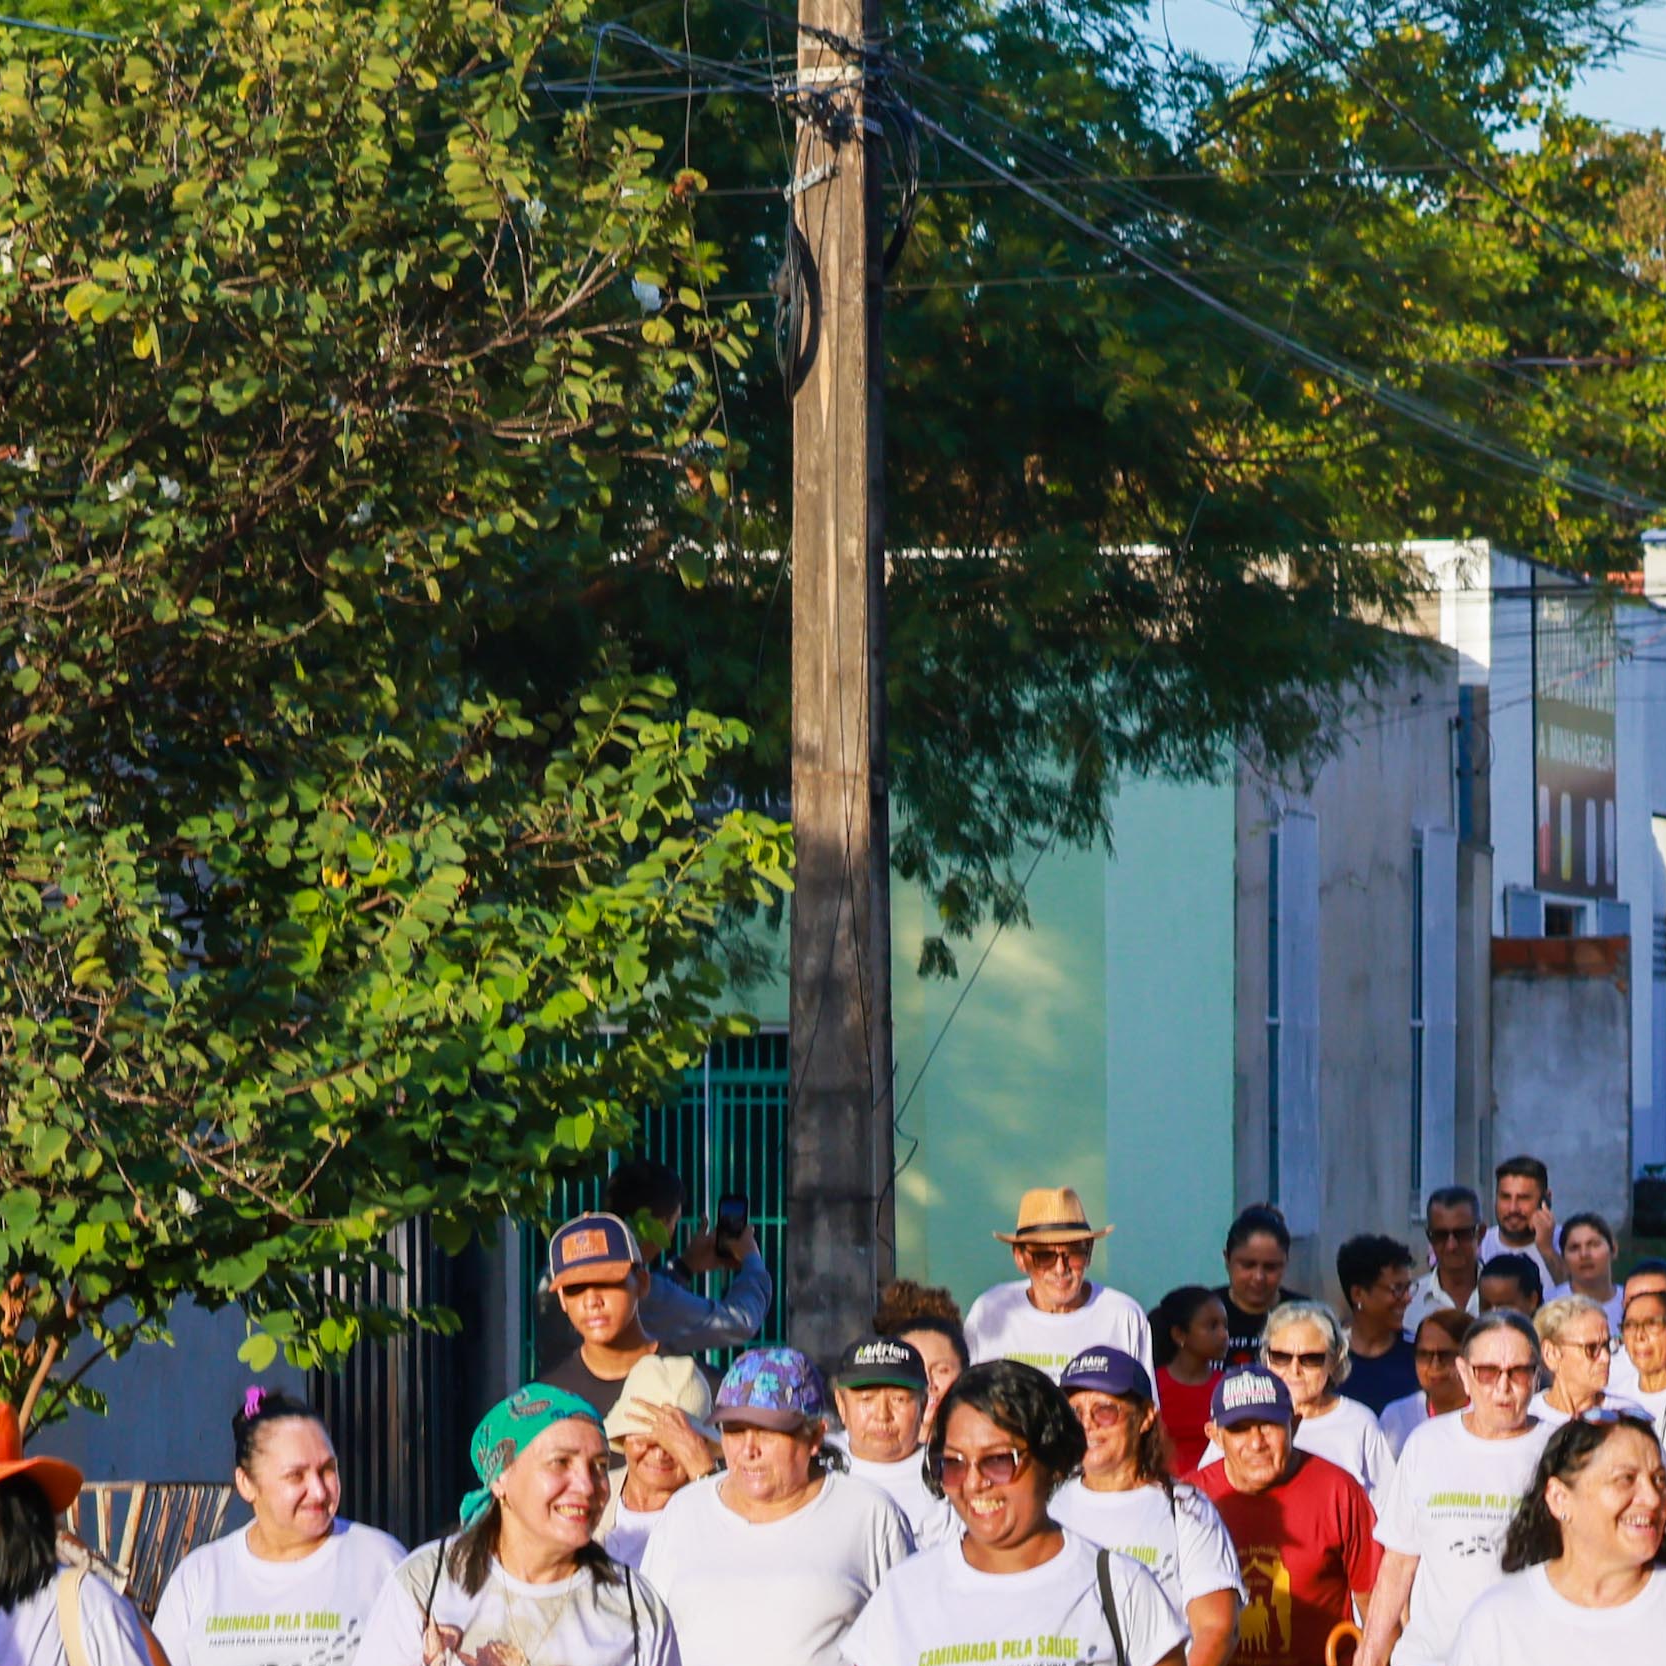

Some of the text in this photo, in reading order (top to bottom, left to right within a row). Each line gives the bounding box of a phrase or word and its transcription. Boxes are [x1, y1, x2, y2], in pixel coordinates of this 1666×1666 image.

[205, 1613, 270, 1635] CAMINHADA
[274, 1612, 300, 1632] PELA
[1002, 1637, 1032, 1659] PELA
